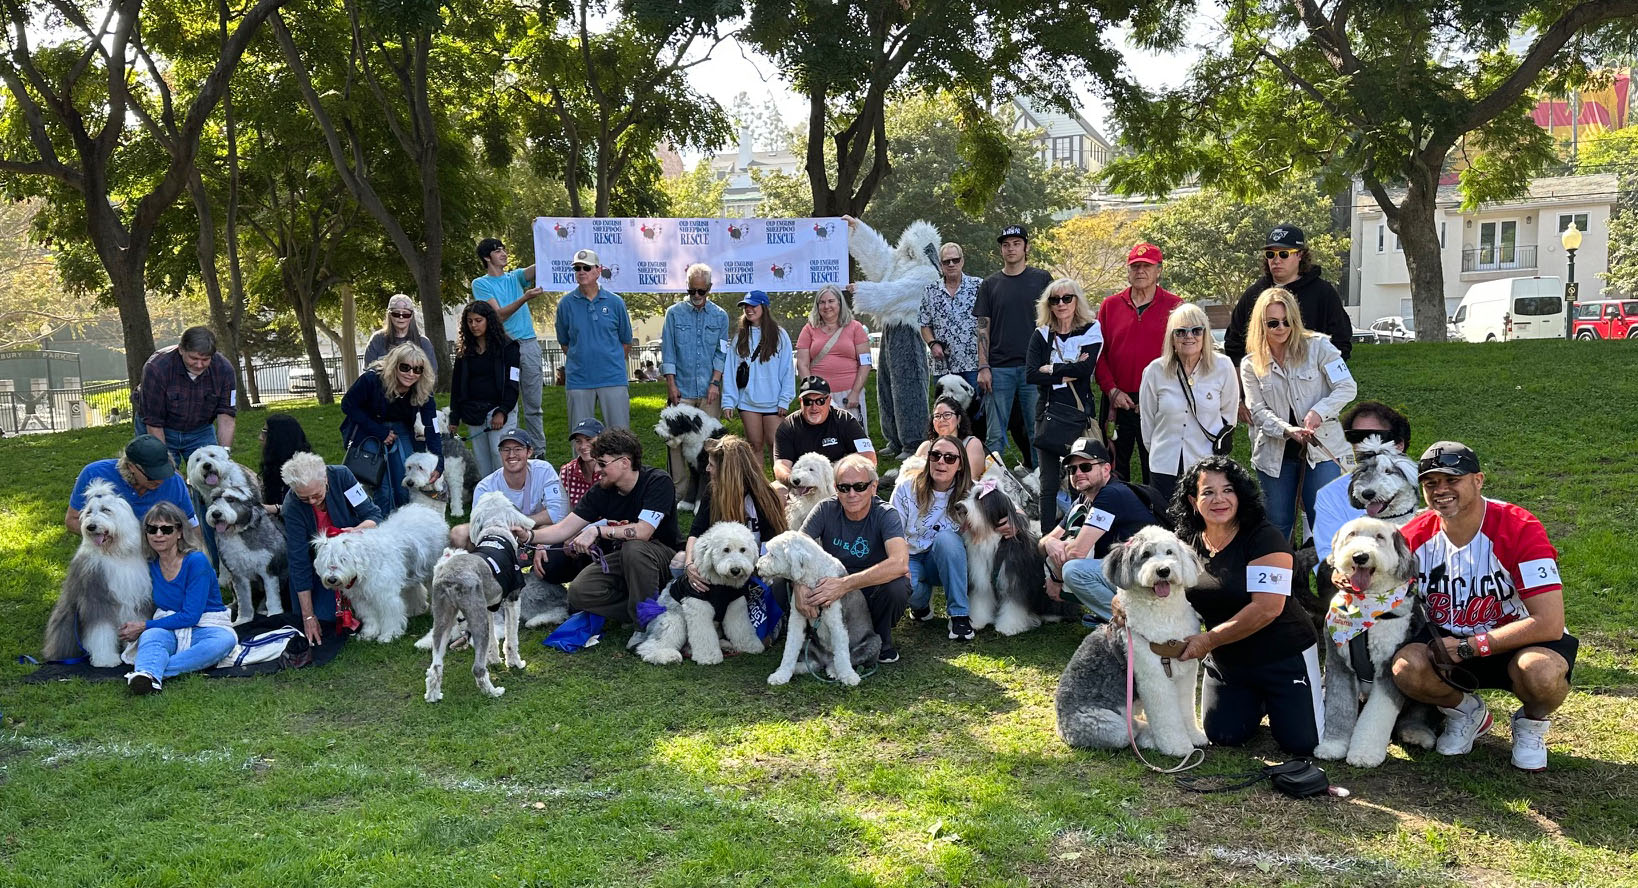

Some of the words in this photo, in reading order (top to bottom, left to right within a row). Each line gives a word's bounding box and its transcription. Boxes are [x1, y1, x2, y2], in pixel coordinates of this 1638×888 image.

[594, 232, 623, 244] RESCUE
[680, 233, 710, 245] RESCUE
[767, 232, 796, 244] RESCUE
[553, 272, 577, 284] RESCU
[639, 274, 668, 284] RESCUE
[725, 273, 754, 284] RESCUE
[811, 272, 840, 284] RESCUE
[650, 512, 660, 520] 17
[1258, 572, 1266, 584] 2
[1538, 567, 1548, 578] 3
[1418, 570, 1514, 609] CHICAGO
[1427, 592, 1502, 628] Bulls
